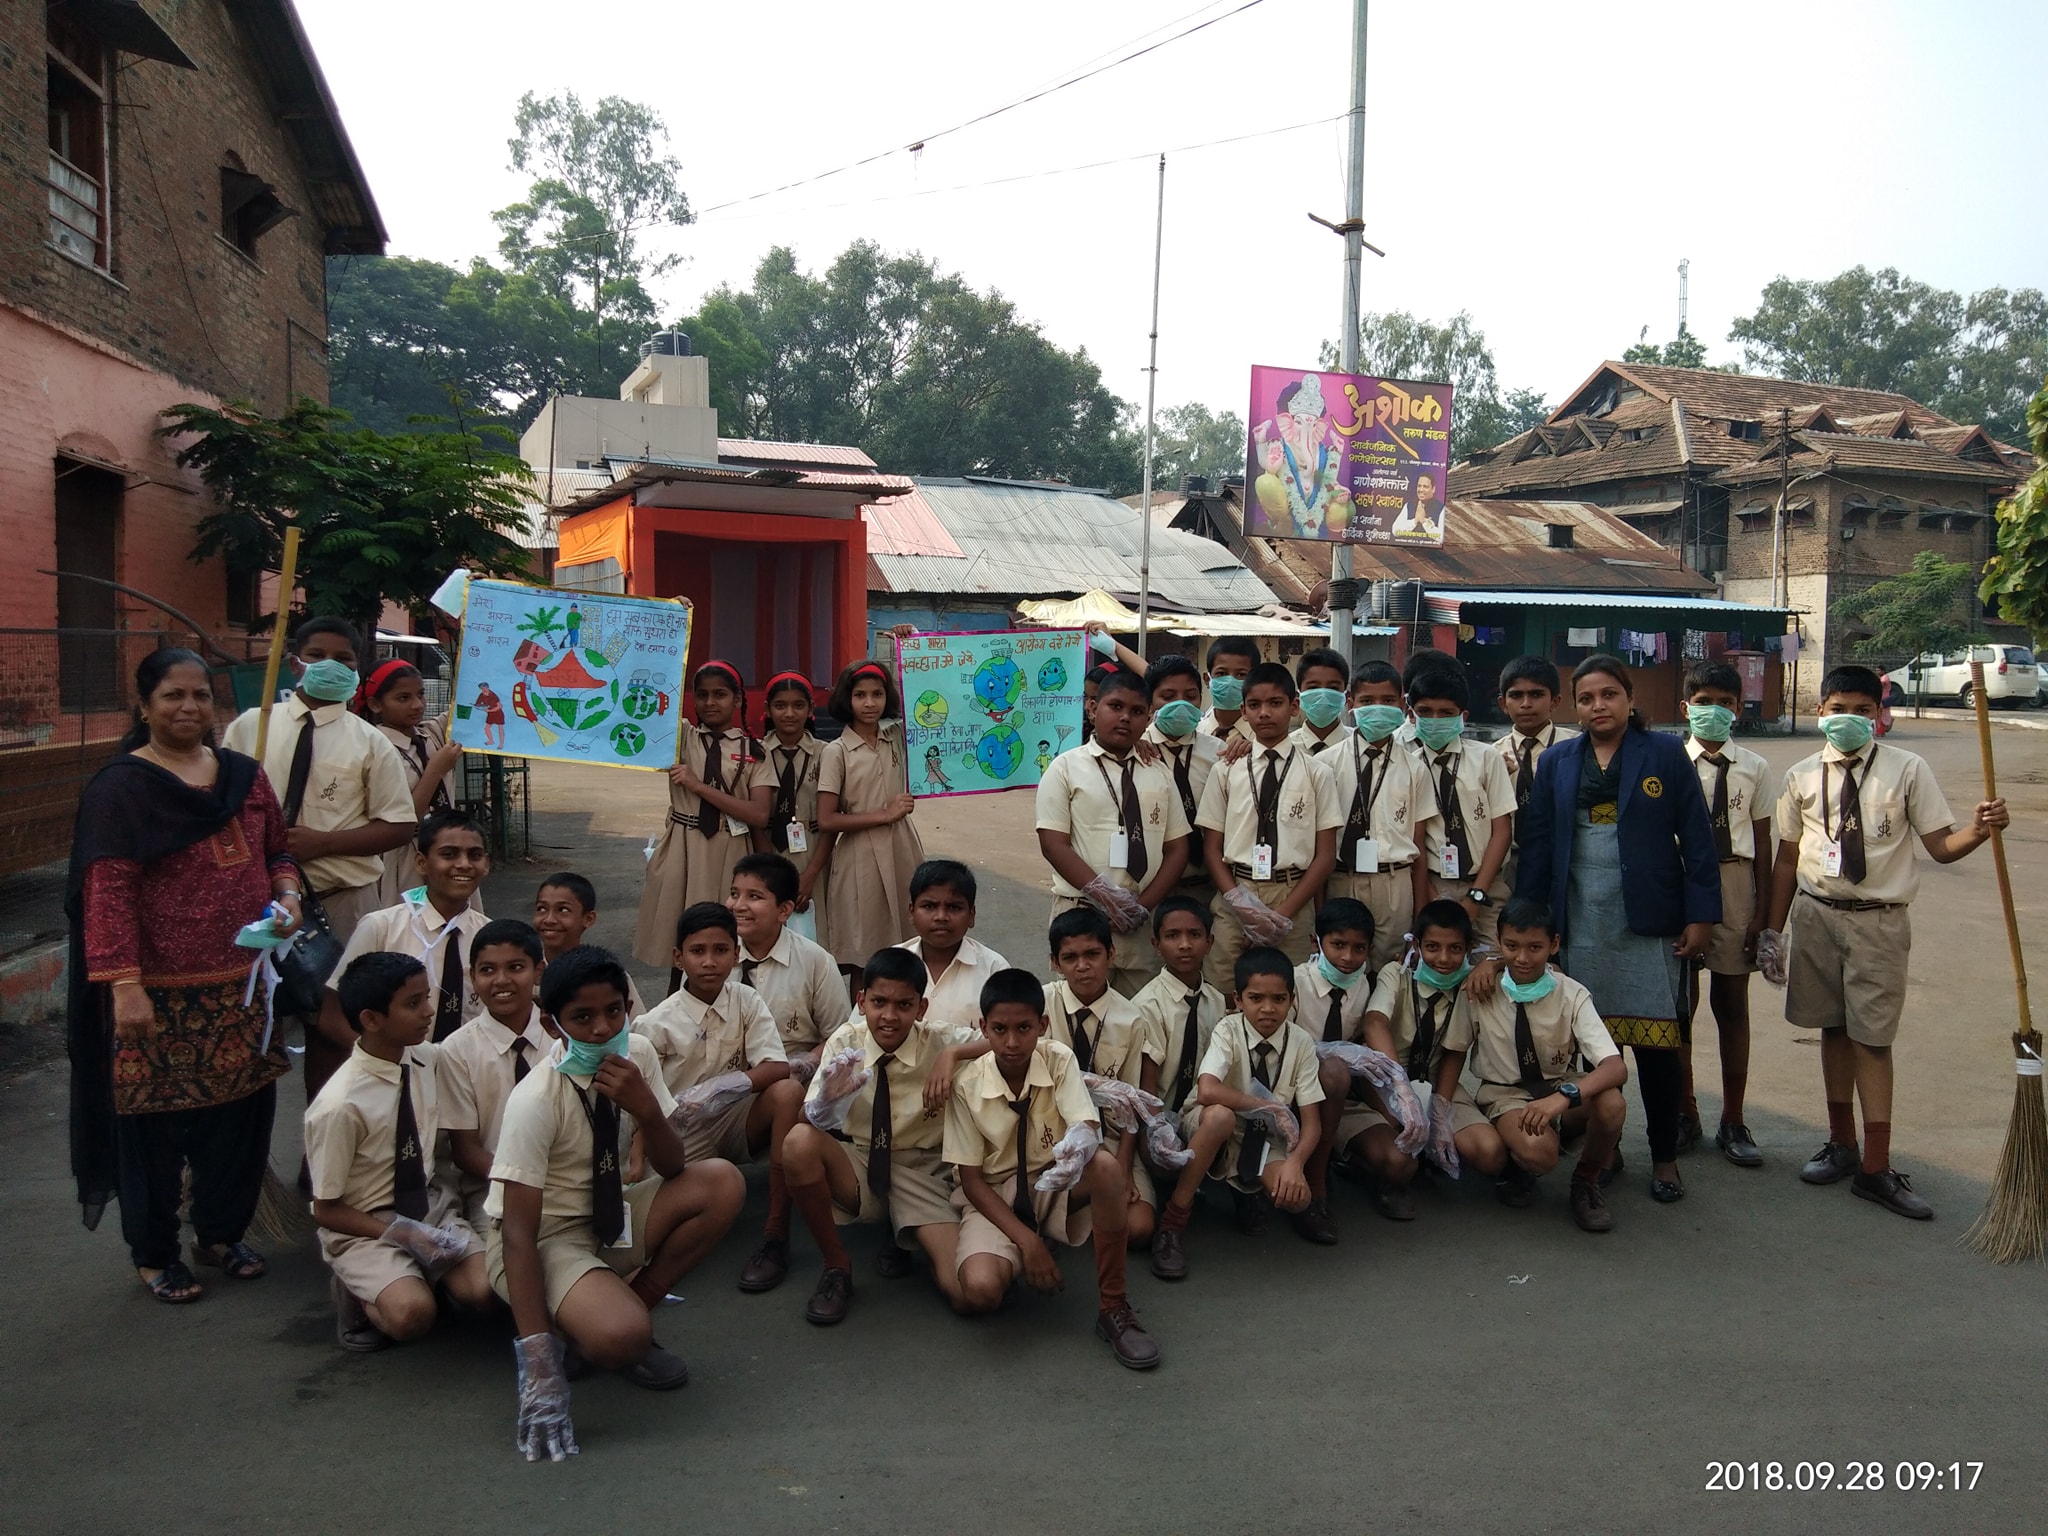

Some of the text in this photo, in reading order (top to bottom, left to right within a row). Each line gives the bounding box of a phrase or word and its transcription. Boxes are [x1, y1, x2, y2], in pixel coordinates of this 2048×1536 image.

[1332, 381, 1442, 459] अशोक
[1403, 427, 1448, 440] तरुण मंडळ
[1351, 440, 1397, 453] सार्वजनिक
[1349, 453, 1397, 466] गणेशोत्सव
[1354, 474, 1409, 491] गणेशभक्तांचे
[1376, 495, 1404, 509] स्वागत
[472, 595, 494, 609] मेरा
[486, 635, 510, 647] भारत
